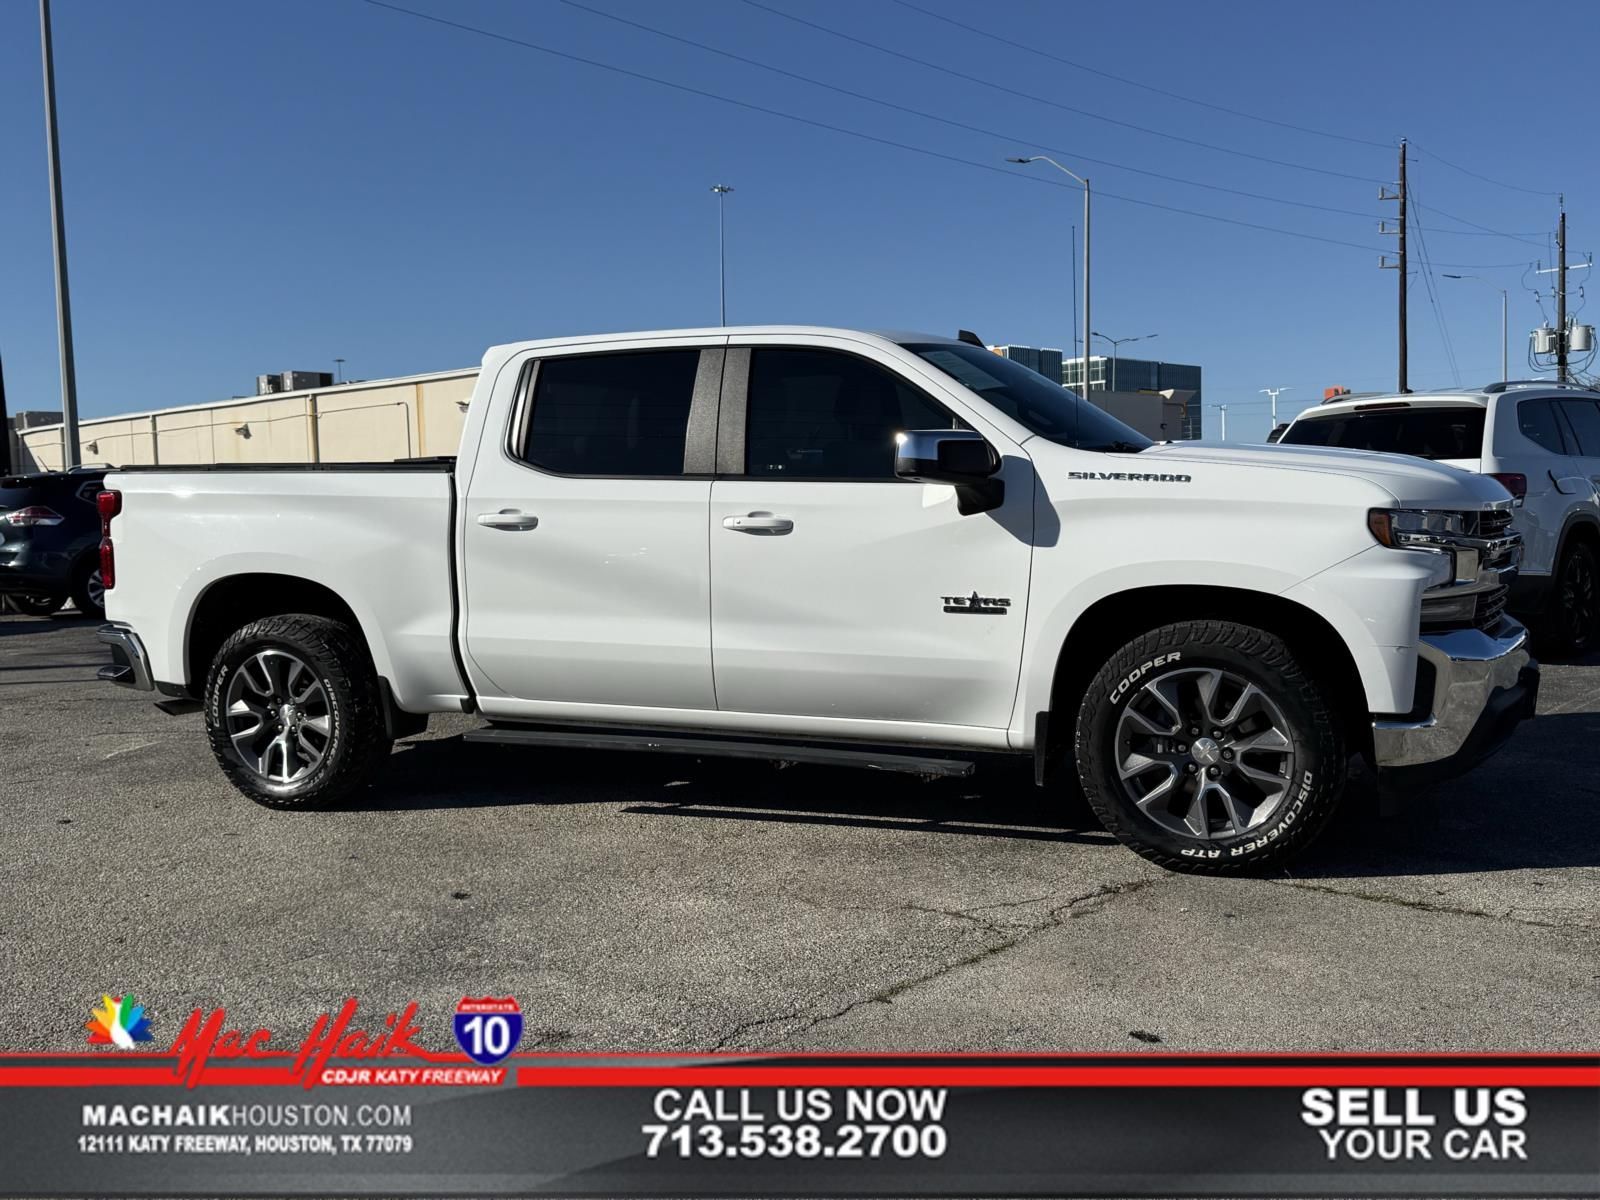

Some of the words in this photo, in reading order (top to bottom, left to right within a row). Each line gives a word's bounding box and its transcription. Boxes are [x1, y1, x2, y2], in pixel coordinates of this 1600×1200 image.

[1068, 471, 1192, 483] SILVERADO
[212, 664, 229, 728] COOPER
[1109, 651, 1182, 704] COOPER
[1230, 770, 1314, 857] DISCOVERER
[1180, 848, 1222, 858] ATP
